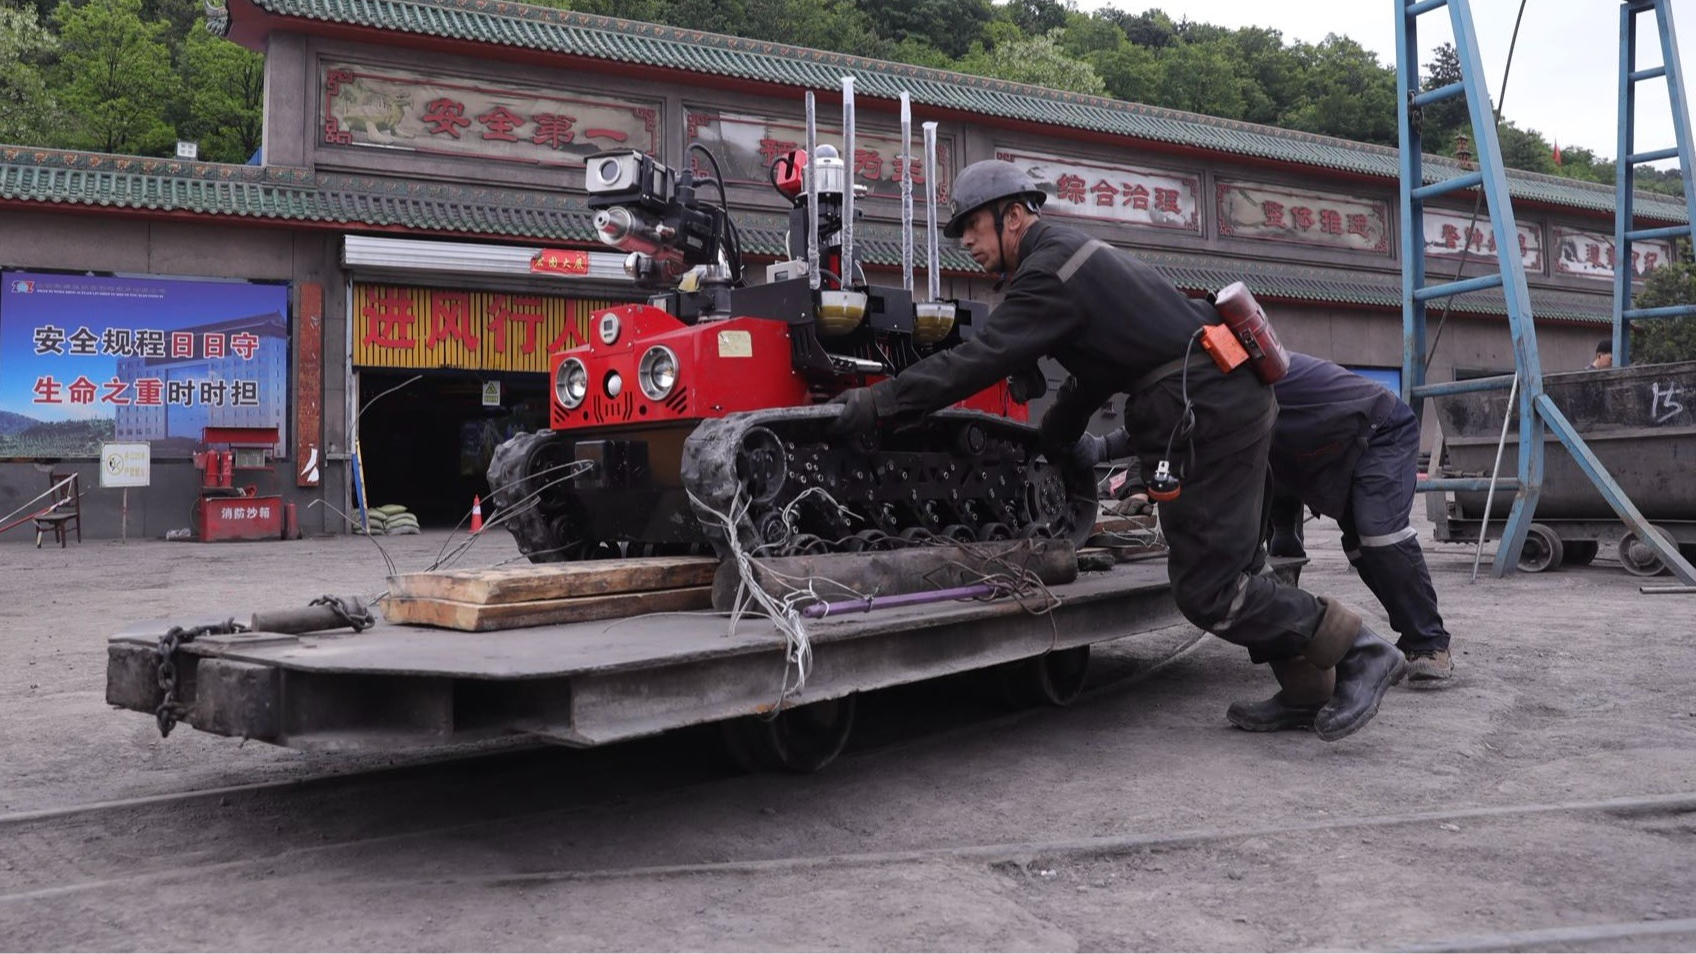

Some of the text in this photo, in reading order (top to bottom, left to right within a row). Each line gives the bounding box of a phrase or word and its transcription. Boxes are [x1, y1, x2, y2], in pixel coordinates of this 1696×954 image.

[422, 97, 629, 149] 安全第一
[759, 138, 926, 184] 预为主
[1057, 173, 1182, 215] 综合治理
[362, 285, 641, 355] 进风行人
[33, 325, 260, 360] 安全规程日日守
[33, 375, 260, 407] 生命之重时时担
[1651, 381, 1684, 423] 15
[221, 506, 271, 520] 消防沙箱
